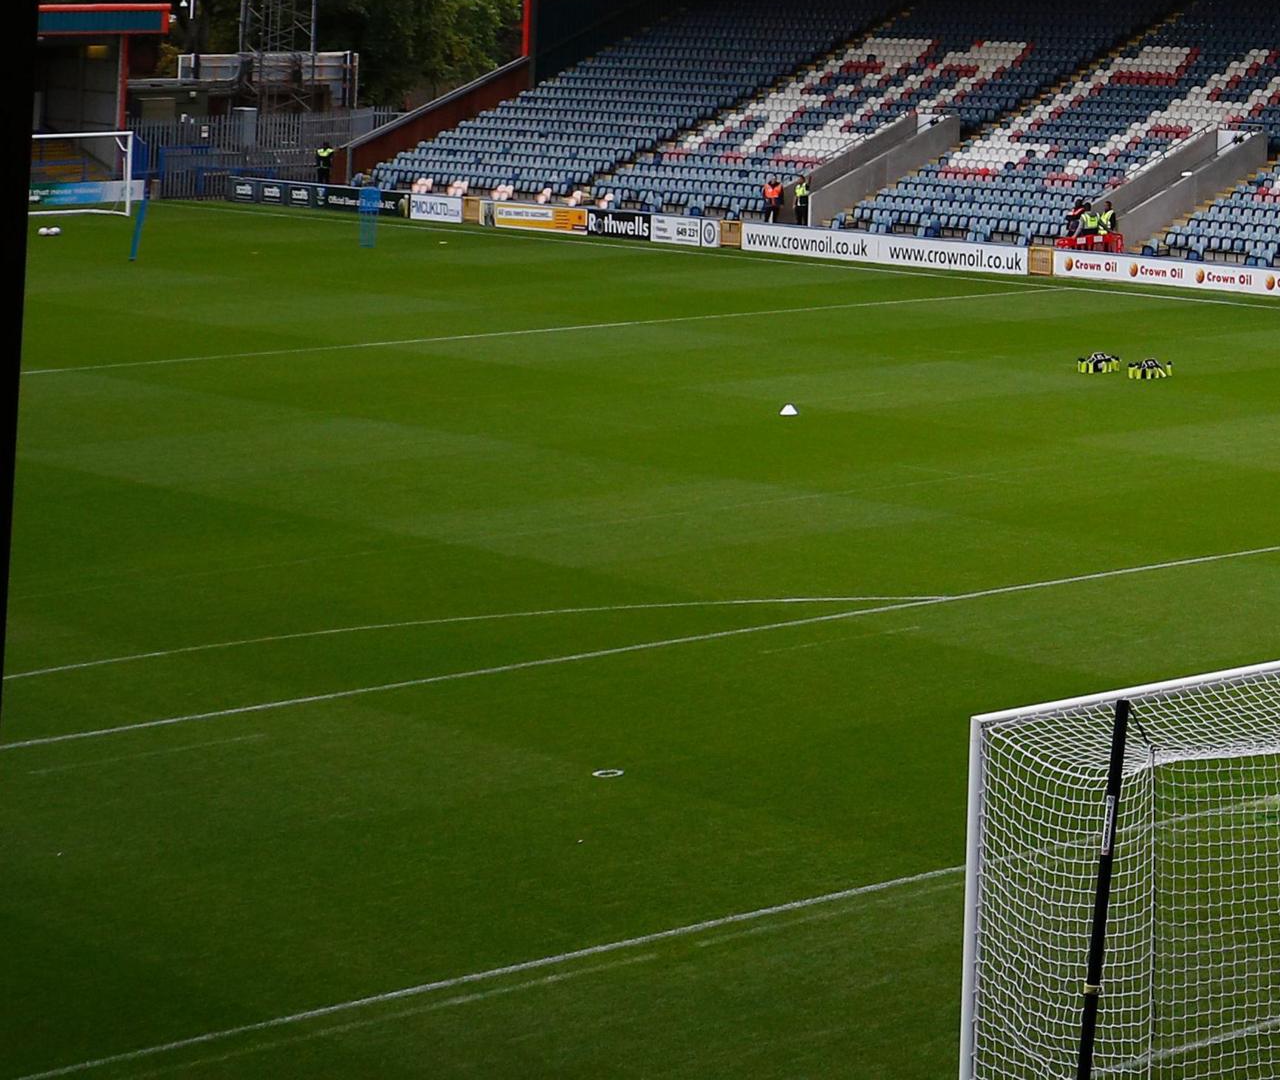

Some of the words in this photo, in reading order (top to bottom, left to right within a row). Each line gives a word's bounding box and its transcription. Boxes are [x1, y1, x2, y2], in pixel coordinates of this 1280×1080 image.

[588, 213, 650, 238] Rothwells
[746, 231, 868, 257] www.crownoil.co.uk
[889, 244, 1023, 272] www.crownoil.co.uk
[1073, 258, 1101, 271] Crown
[1103, 259, 1117, 273] Oil
[1138, 264, 1167, 278] Crown
[1170, 264, 1184, 279] Oil
[1205, 271, 1234, 285] Crown
[1237, 272, 1252, 286] Oil
